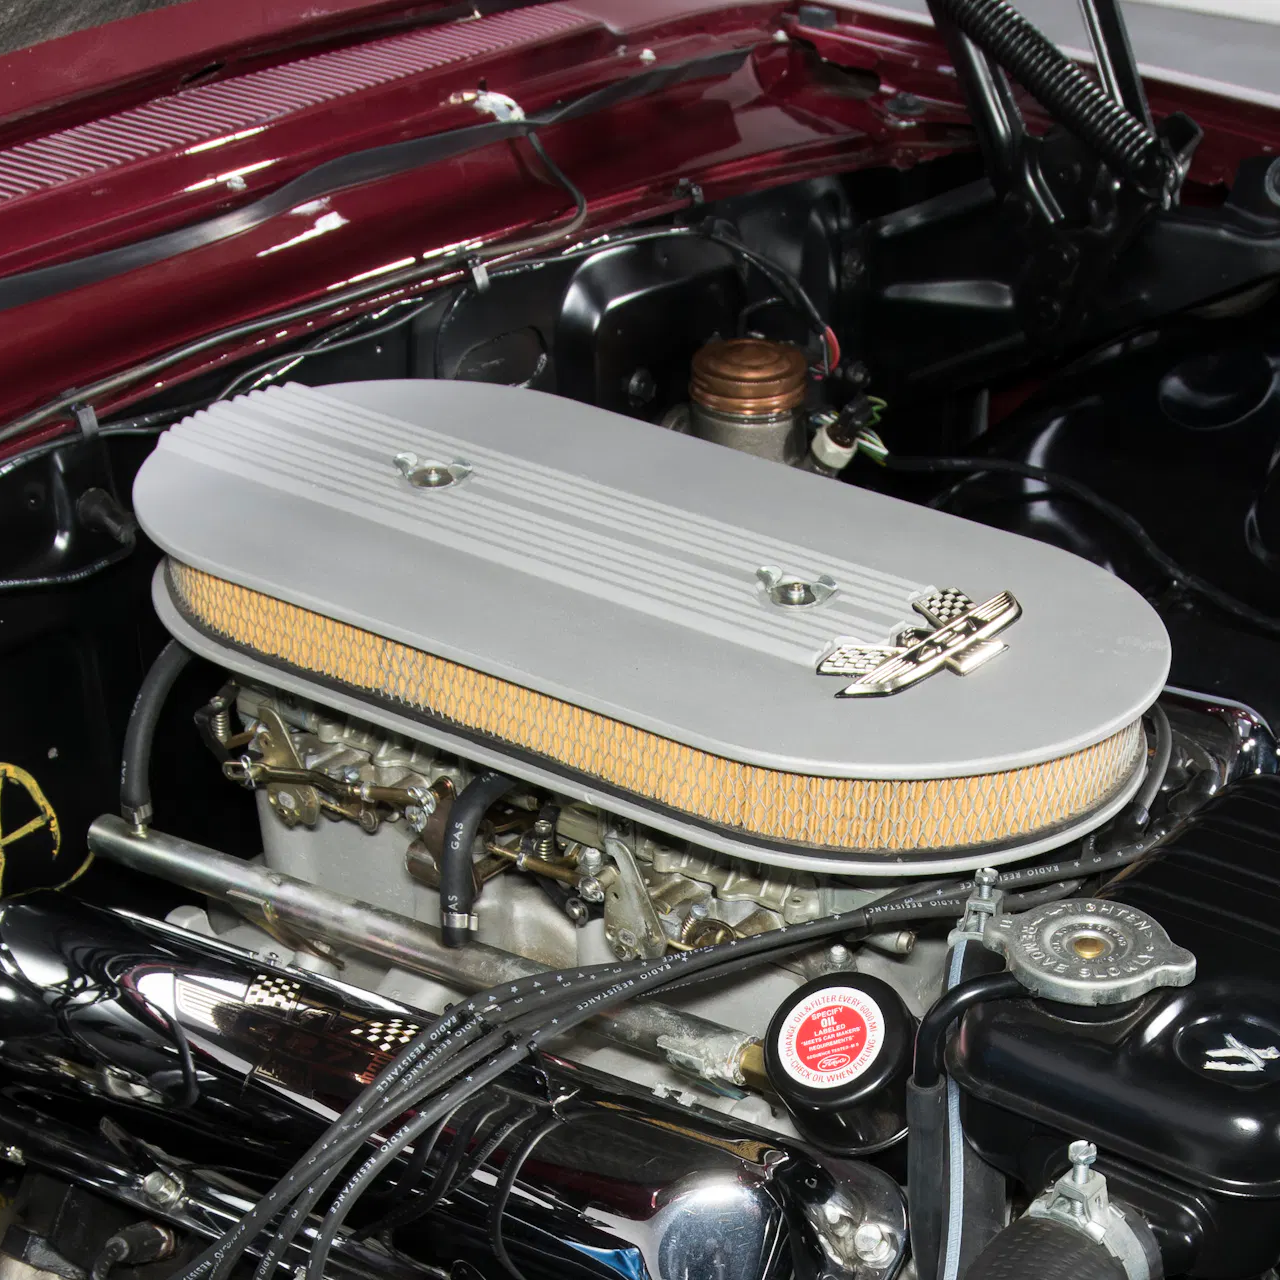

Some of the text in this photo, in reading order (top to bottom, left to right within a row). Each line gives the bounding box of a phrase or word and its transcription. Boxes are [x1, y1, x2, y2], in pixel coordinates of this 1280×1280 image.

[451, 821, 464, 849] GAS
[1027, 865, 1060, 878] RADIO
[867, 901, 924, 914] RESISTANC
[639, 963, 671, 980] RADIO
[576, 980, 635, 1012] RESISTANCE
[786, 1023, 797, 1059] CHANGE
[810, 994, 837, 1009] FILTER
[838, 994, 862, 1008] EVERY
[811, 1006, 844, 1021] SPECIFY
[820, 1016, 838, 1028] OIL
[429, 1014, 458, 1042] RADIO
[813, 1024, 846, 1037] LABELED
[823, 1033, 836, 1043] CAR
[400, 1014, 484, 1087] RADIO RESISTANCE
[790, 1039, 877, 1084] CHECK OIL WHEN FUELING
[376, 1042, 426, 1093] RESISTANCE
[330, 1125, 410, 1215] RADIO RESISTANCE
